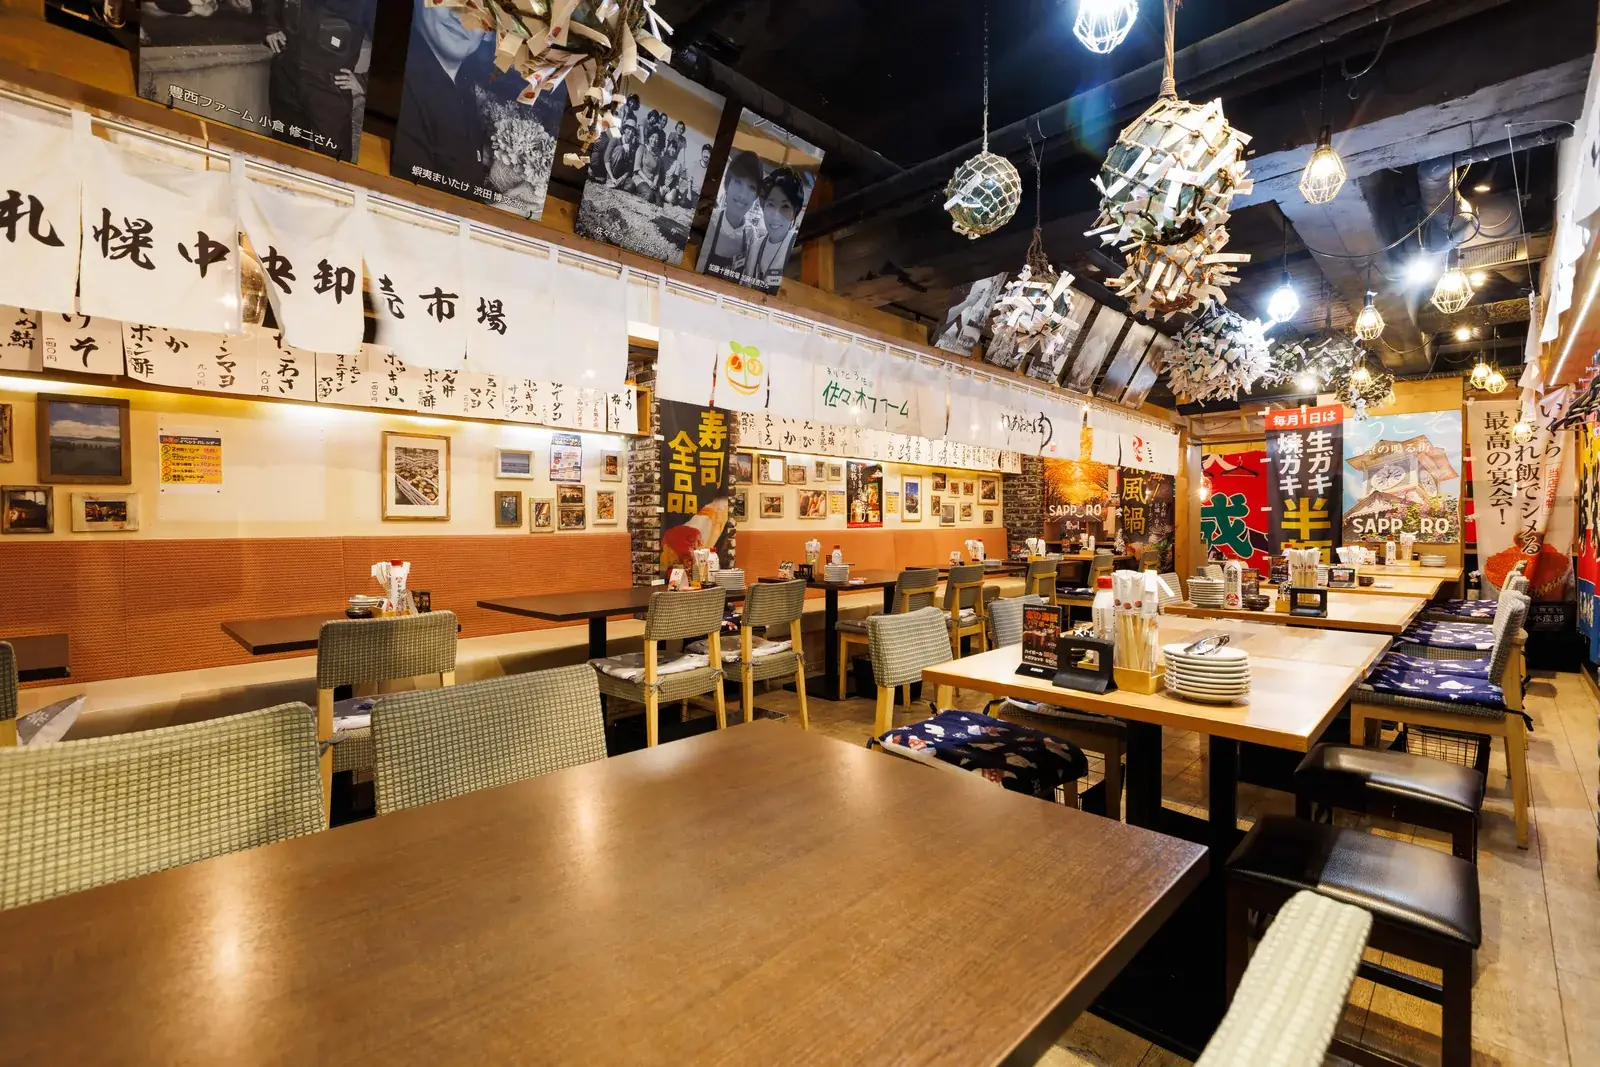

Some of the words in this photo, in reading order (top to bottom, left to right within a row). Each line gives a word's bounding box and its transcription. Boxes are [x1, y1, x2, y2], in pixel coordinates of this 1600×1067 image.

[169, 85, 254, 123] 豊西ファーム
[258, 115, 285, 134] 小倉
[698, 409, 727, 490] 寿司
[1272, 410, 1337, 427] 毎月1日は
[668, 430, 699, 514] 全品
[1277, 433, 1304, 496] 焼ガキ
[1305, 430, 1334, 496] 生ガキ
[1483, 411, 1515, 526] 最高の宴会！
